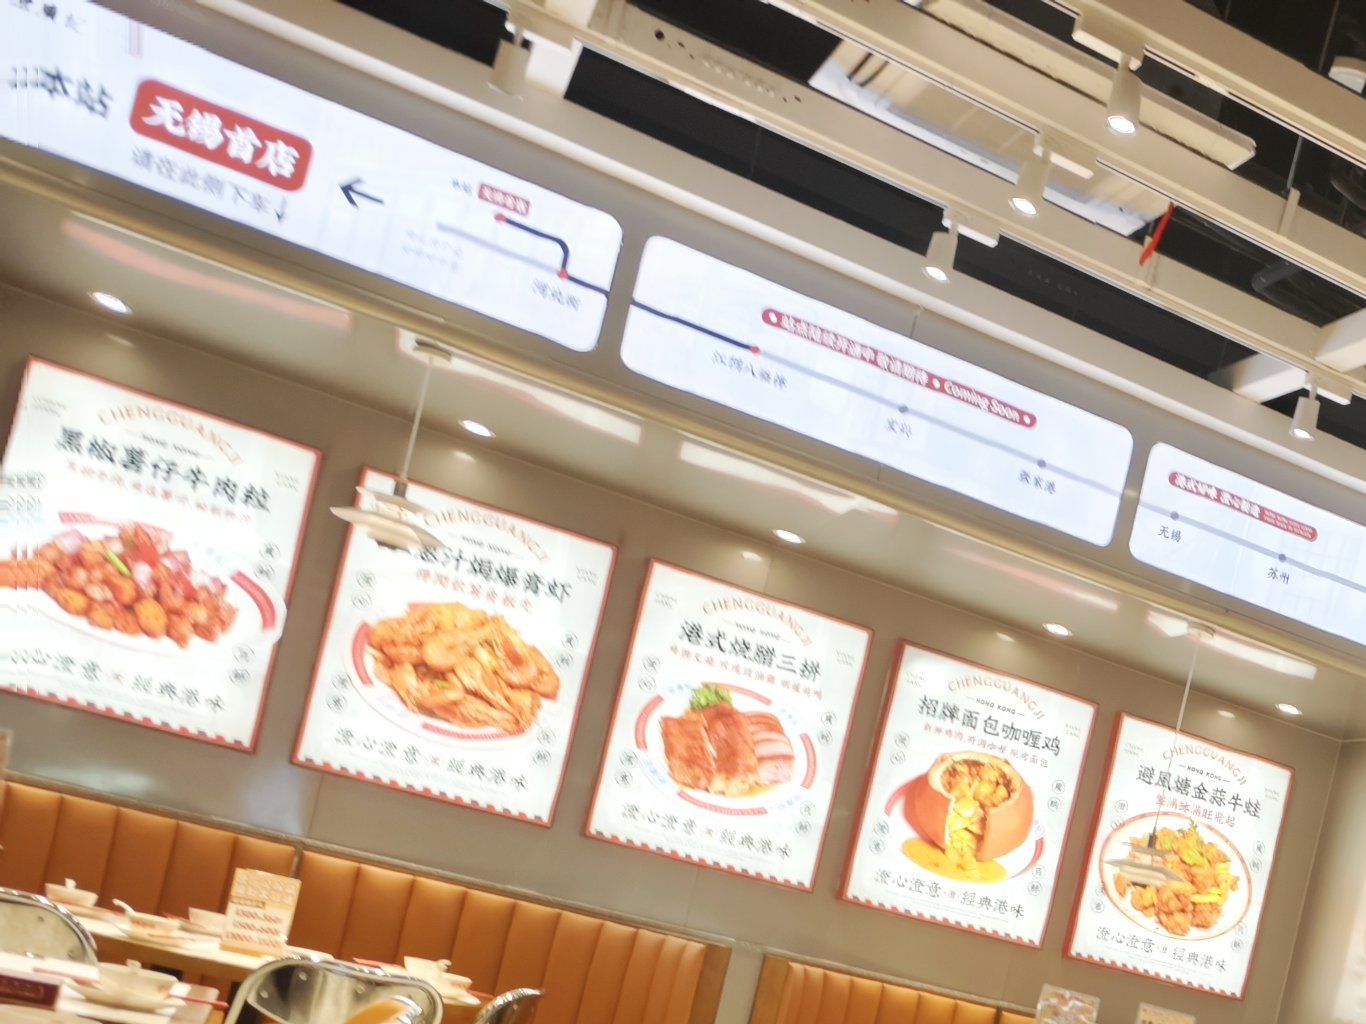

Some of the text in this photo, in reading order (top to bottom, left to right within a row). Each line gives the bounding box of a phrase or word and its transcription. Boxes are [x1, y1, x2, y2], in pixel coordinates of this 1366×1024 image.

[141, 95, 301, 179] 无锡首店
[944, 380, 989, 411] Coming
[988, 397, 1021, 423] Soon
[1157, 525, 1182, 543] 无锡
[1267, 566, 1290, 585] 苏州
[948, 674, 1045, 721] CHENGGUANGJI
[917, 693, 1061, 758] 招牌面包咖喱鸡
